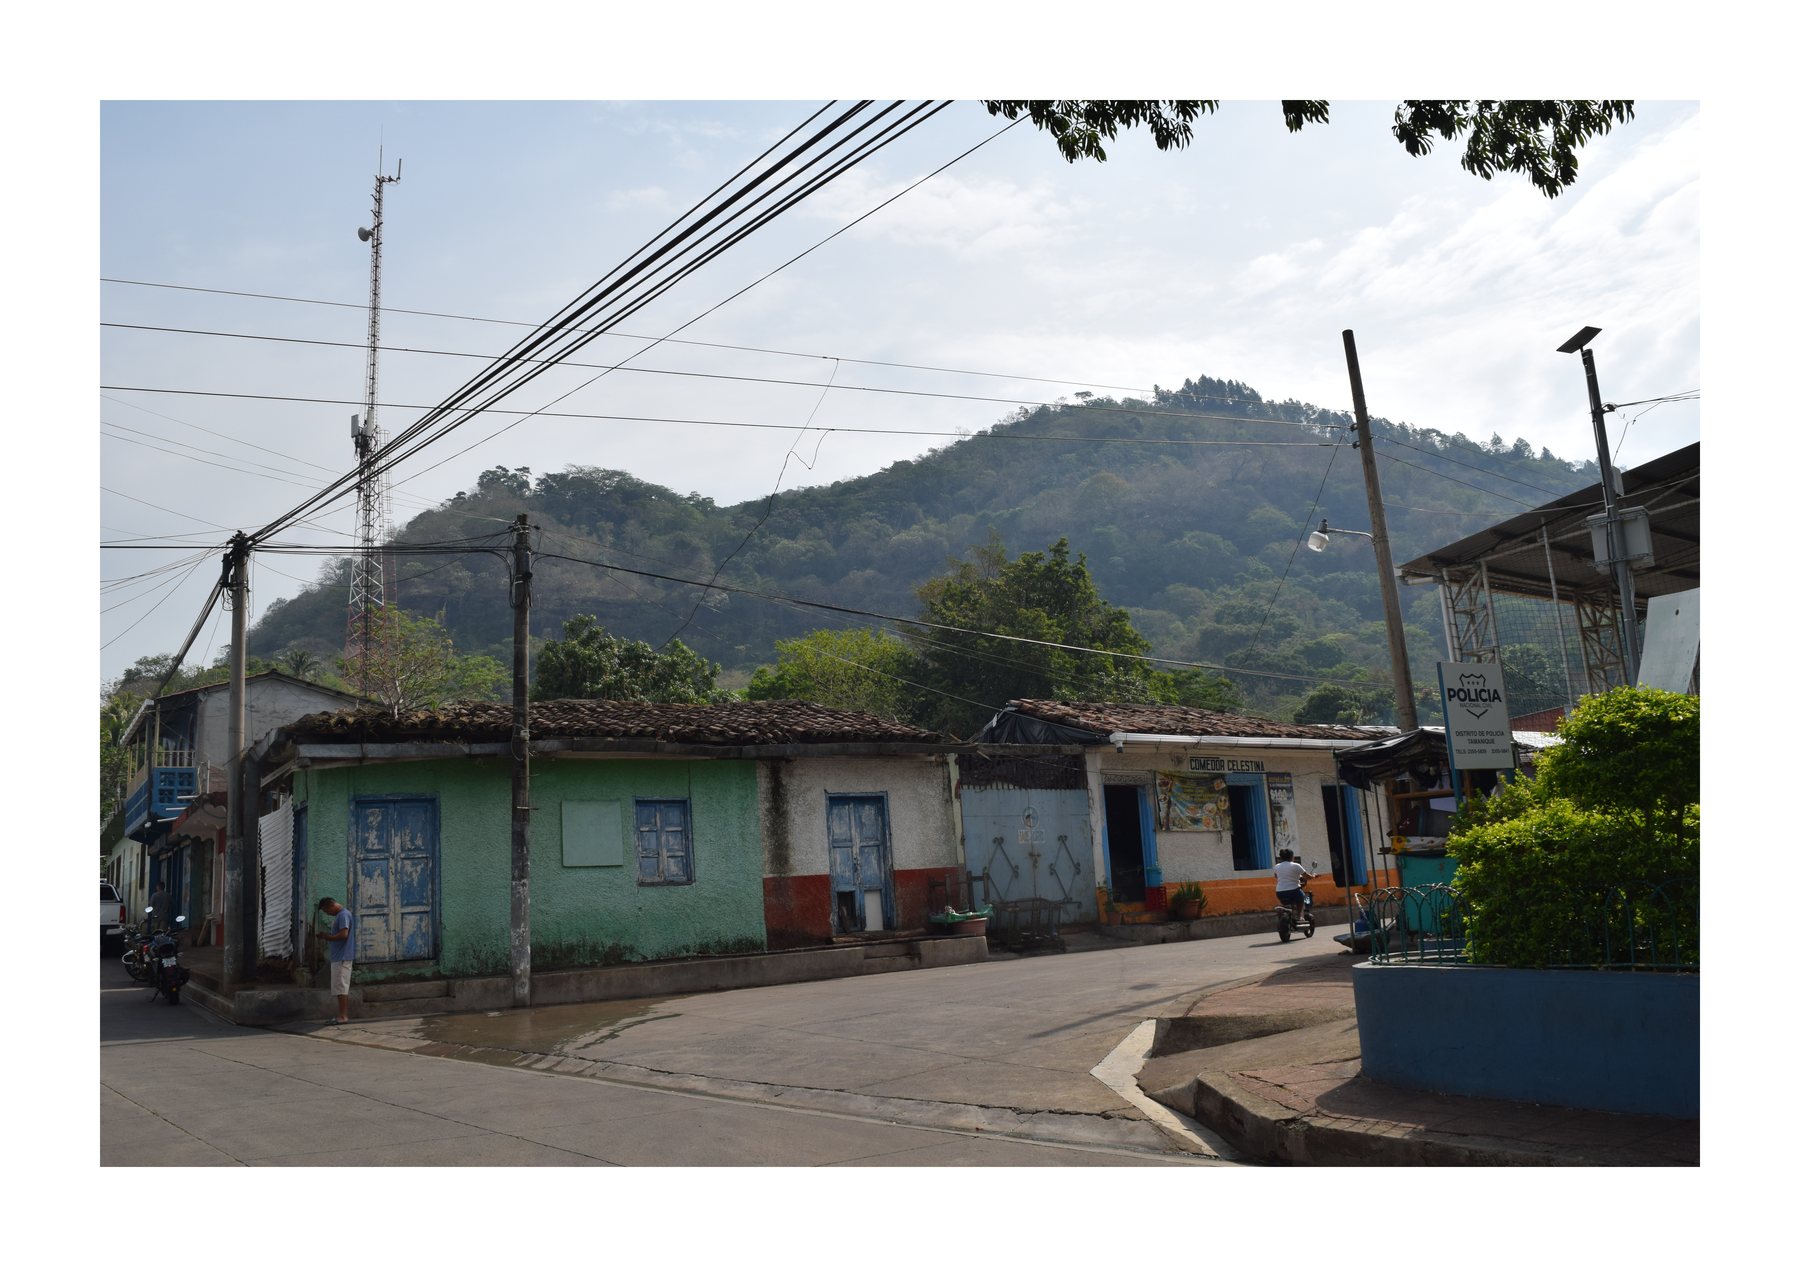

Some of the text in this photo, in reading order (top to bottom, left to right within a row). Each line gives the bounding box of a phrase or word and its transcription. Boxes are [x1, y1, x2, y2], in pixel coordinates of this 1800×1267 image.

[1447, 688, 1502, 702] POLICIA
[1189, 758, 1265, 772] COMEDOR CELESTINA
